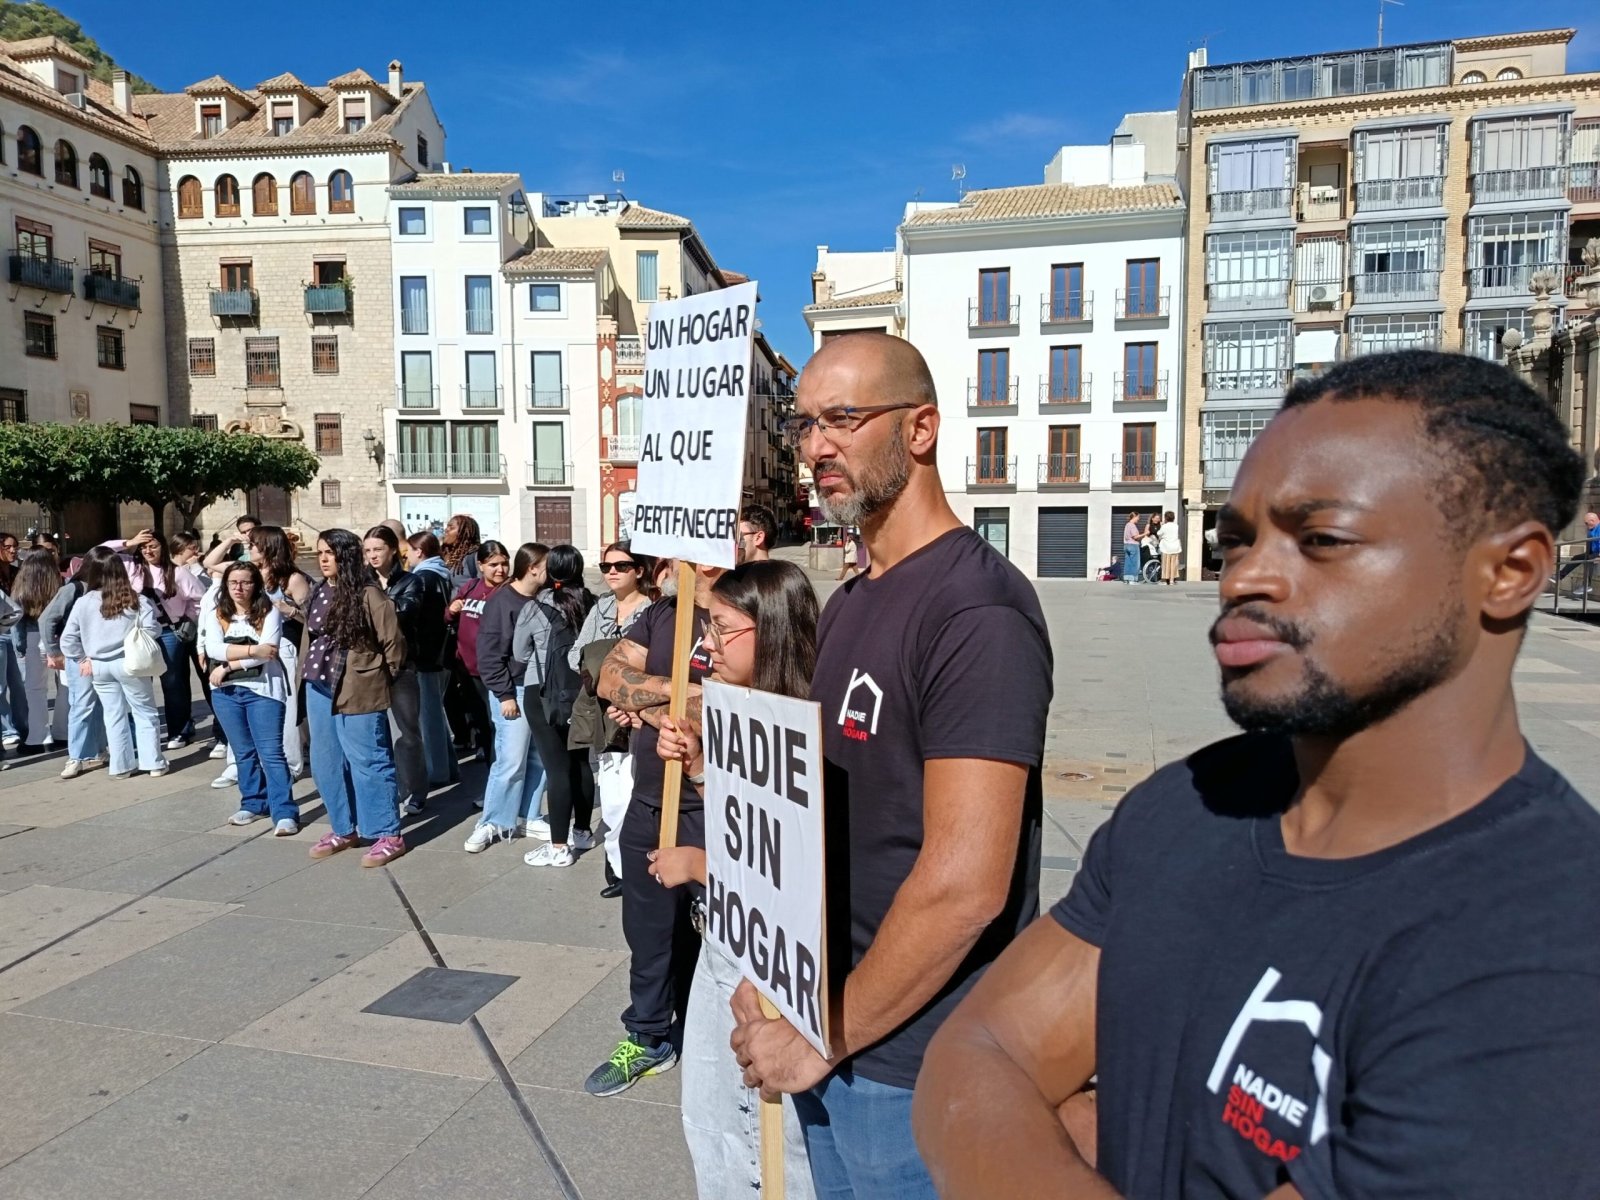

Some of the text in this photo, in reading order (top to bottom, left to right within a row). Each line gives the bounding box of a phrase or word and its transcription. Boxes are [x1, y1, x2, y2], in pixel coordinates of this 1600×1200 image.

[647, 304, 749, 350] UN HOGAR
[645, 364, 744, 399] UN LUGAR
[641, 429, 714, 466] AL QUE
[846, 709, 866, 723] NADIE
[706, 705, 809, 808] NADIE
[724, 794, 782, 891] SIN
[707, 872, 822, 1040] HOGAR
[1227, 1084, 1265, 1124] SIN
[1232, 1063, 1309, 1128] NADIE
